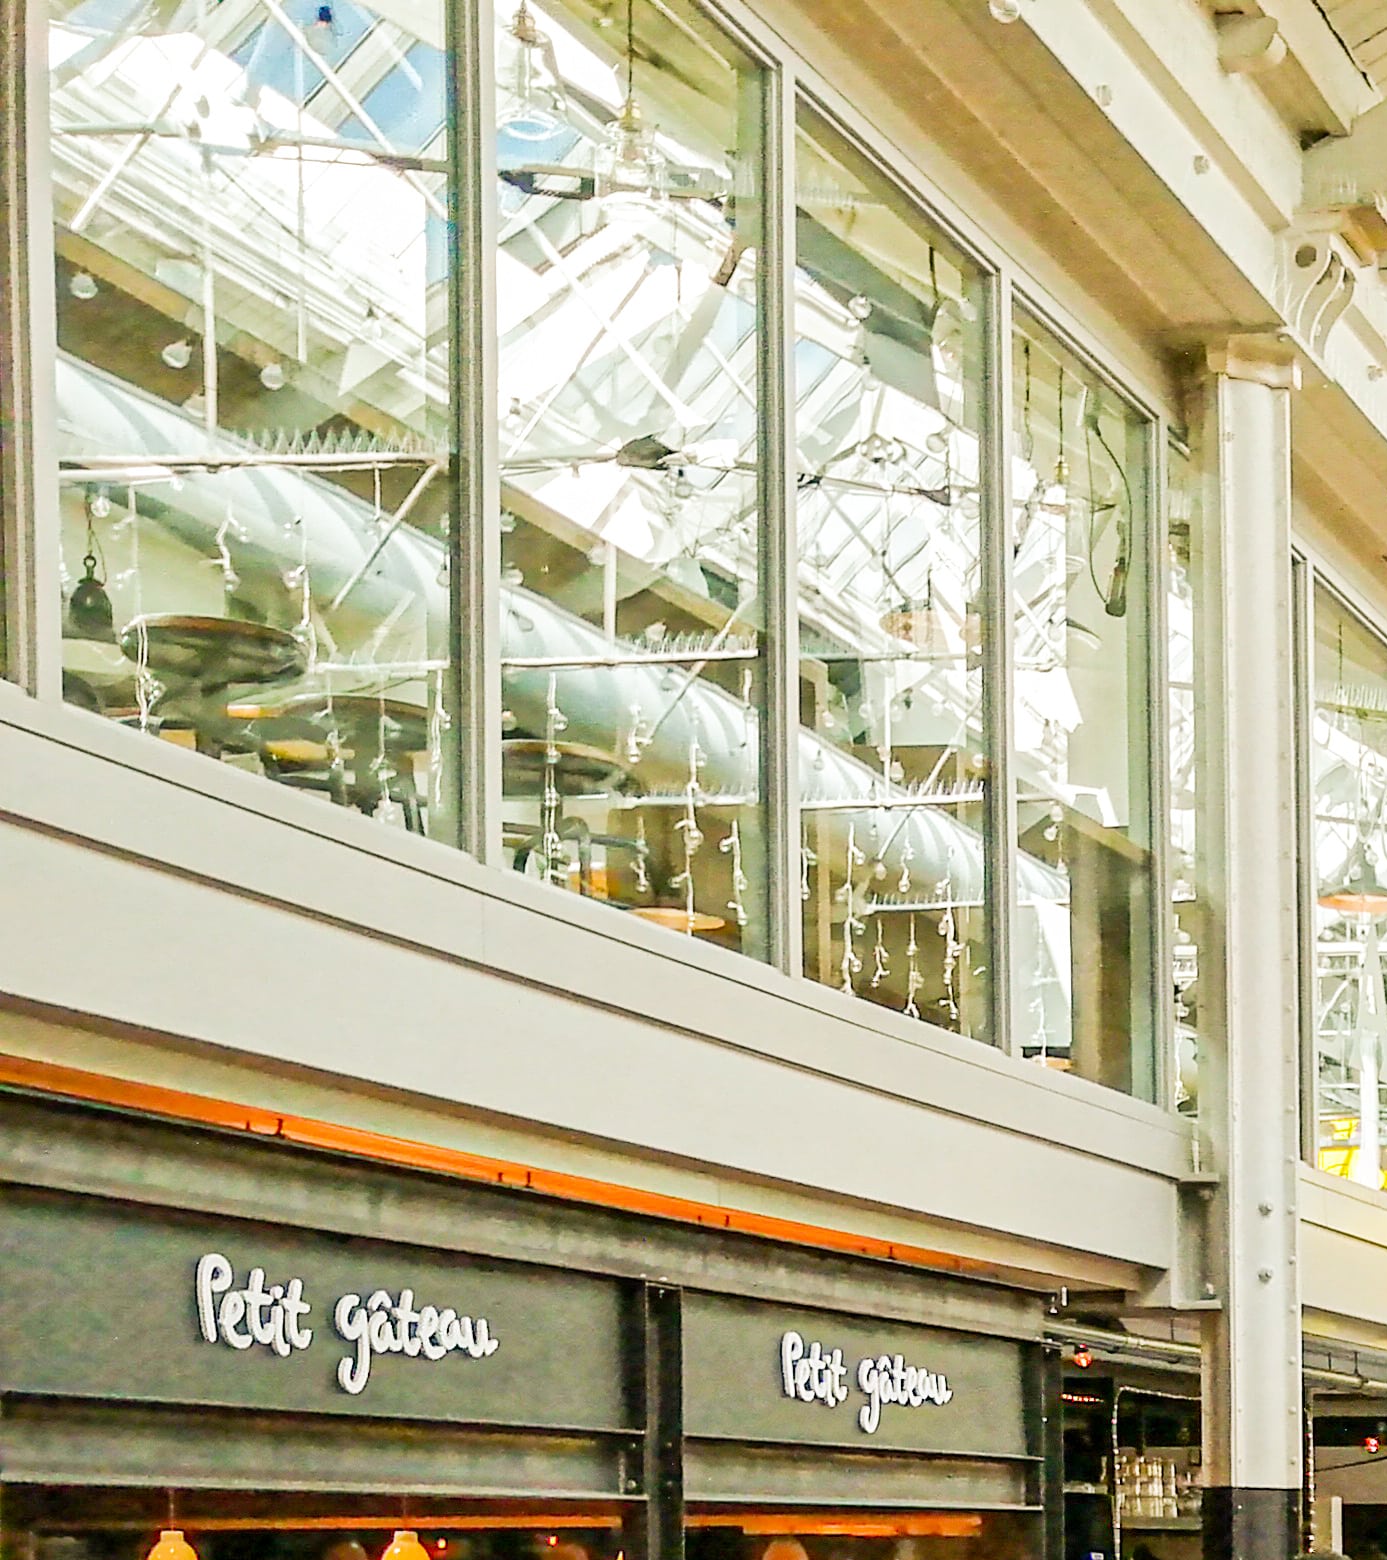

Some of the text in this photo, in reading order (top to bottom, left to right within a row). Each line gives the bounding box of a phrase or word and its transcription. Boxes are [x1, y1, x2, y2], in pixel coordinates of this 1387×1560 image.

[195, 1251, 500, 1396] Petit gâteau
[779, 1329, 954, 1434] Petit gâteau
